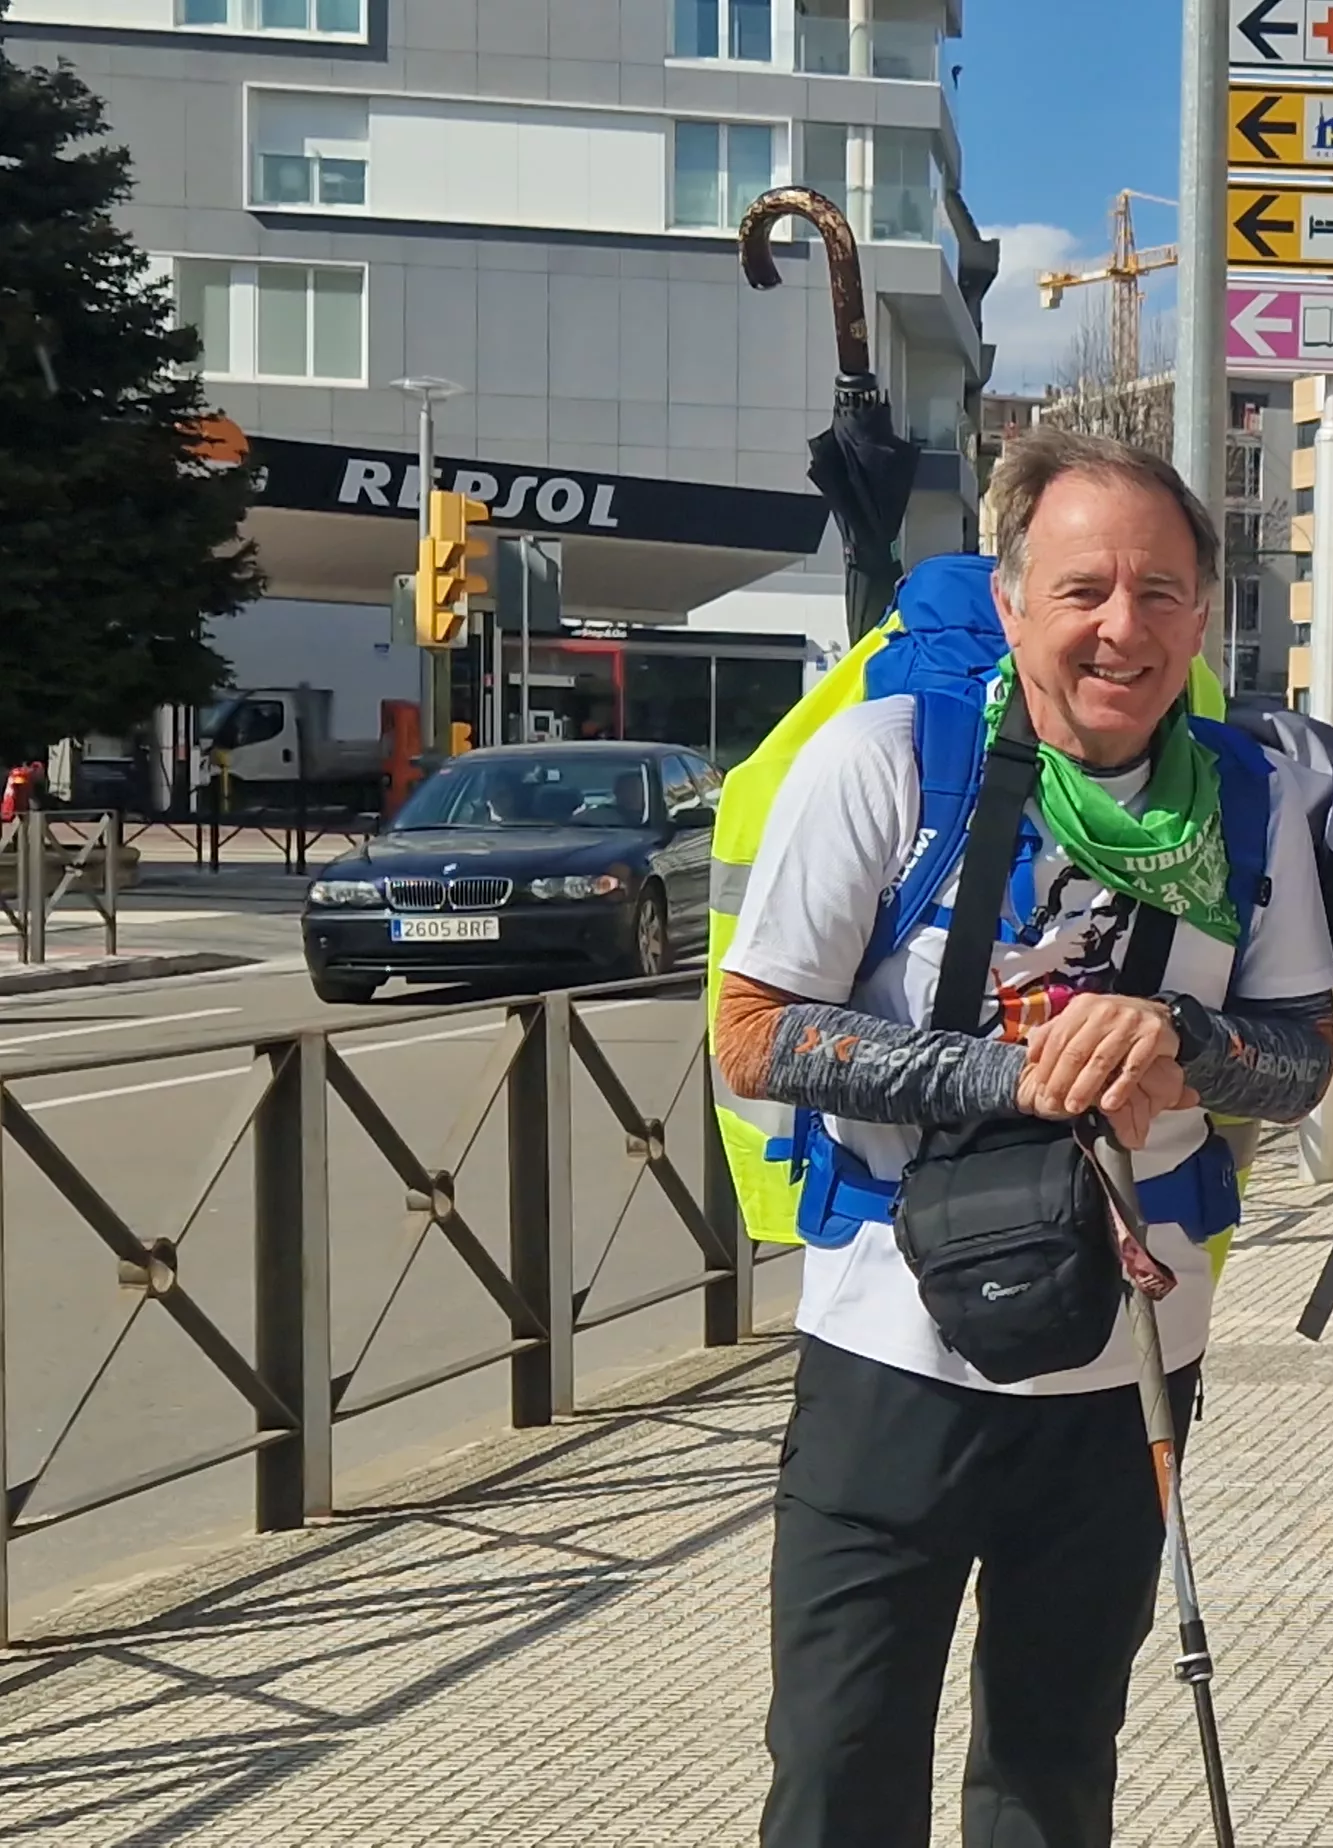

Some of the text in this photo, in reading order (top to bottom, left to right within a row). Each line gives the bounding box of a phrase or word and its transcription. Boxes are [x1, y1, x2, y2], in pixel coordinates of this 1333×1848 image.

[338, 459, 619, 528] REPSOL
[404, 920, 495, 937] 2605 BRF
